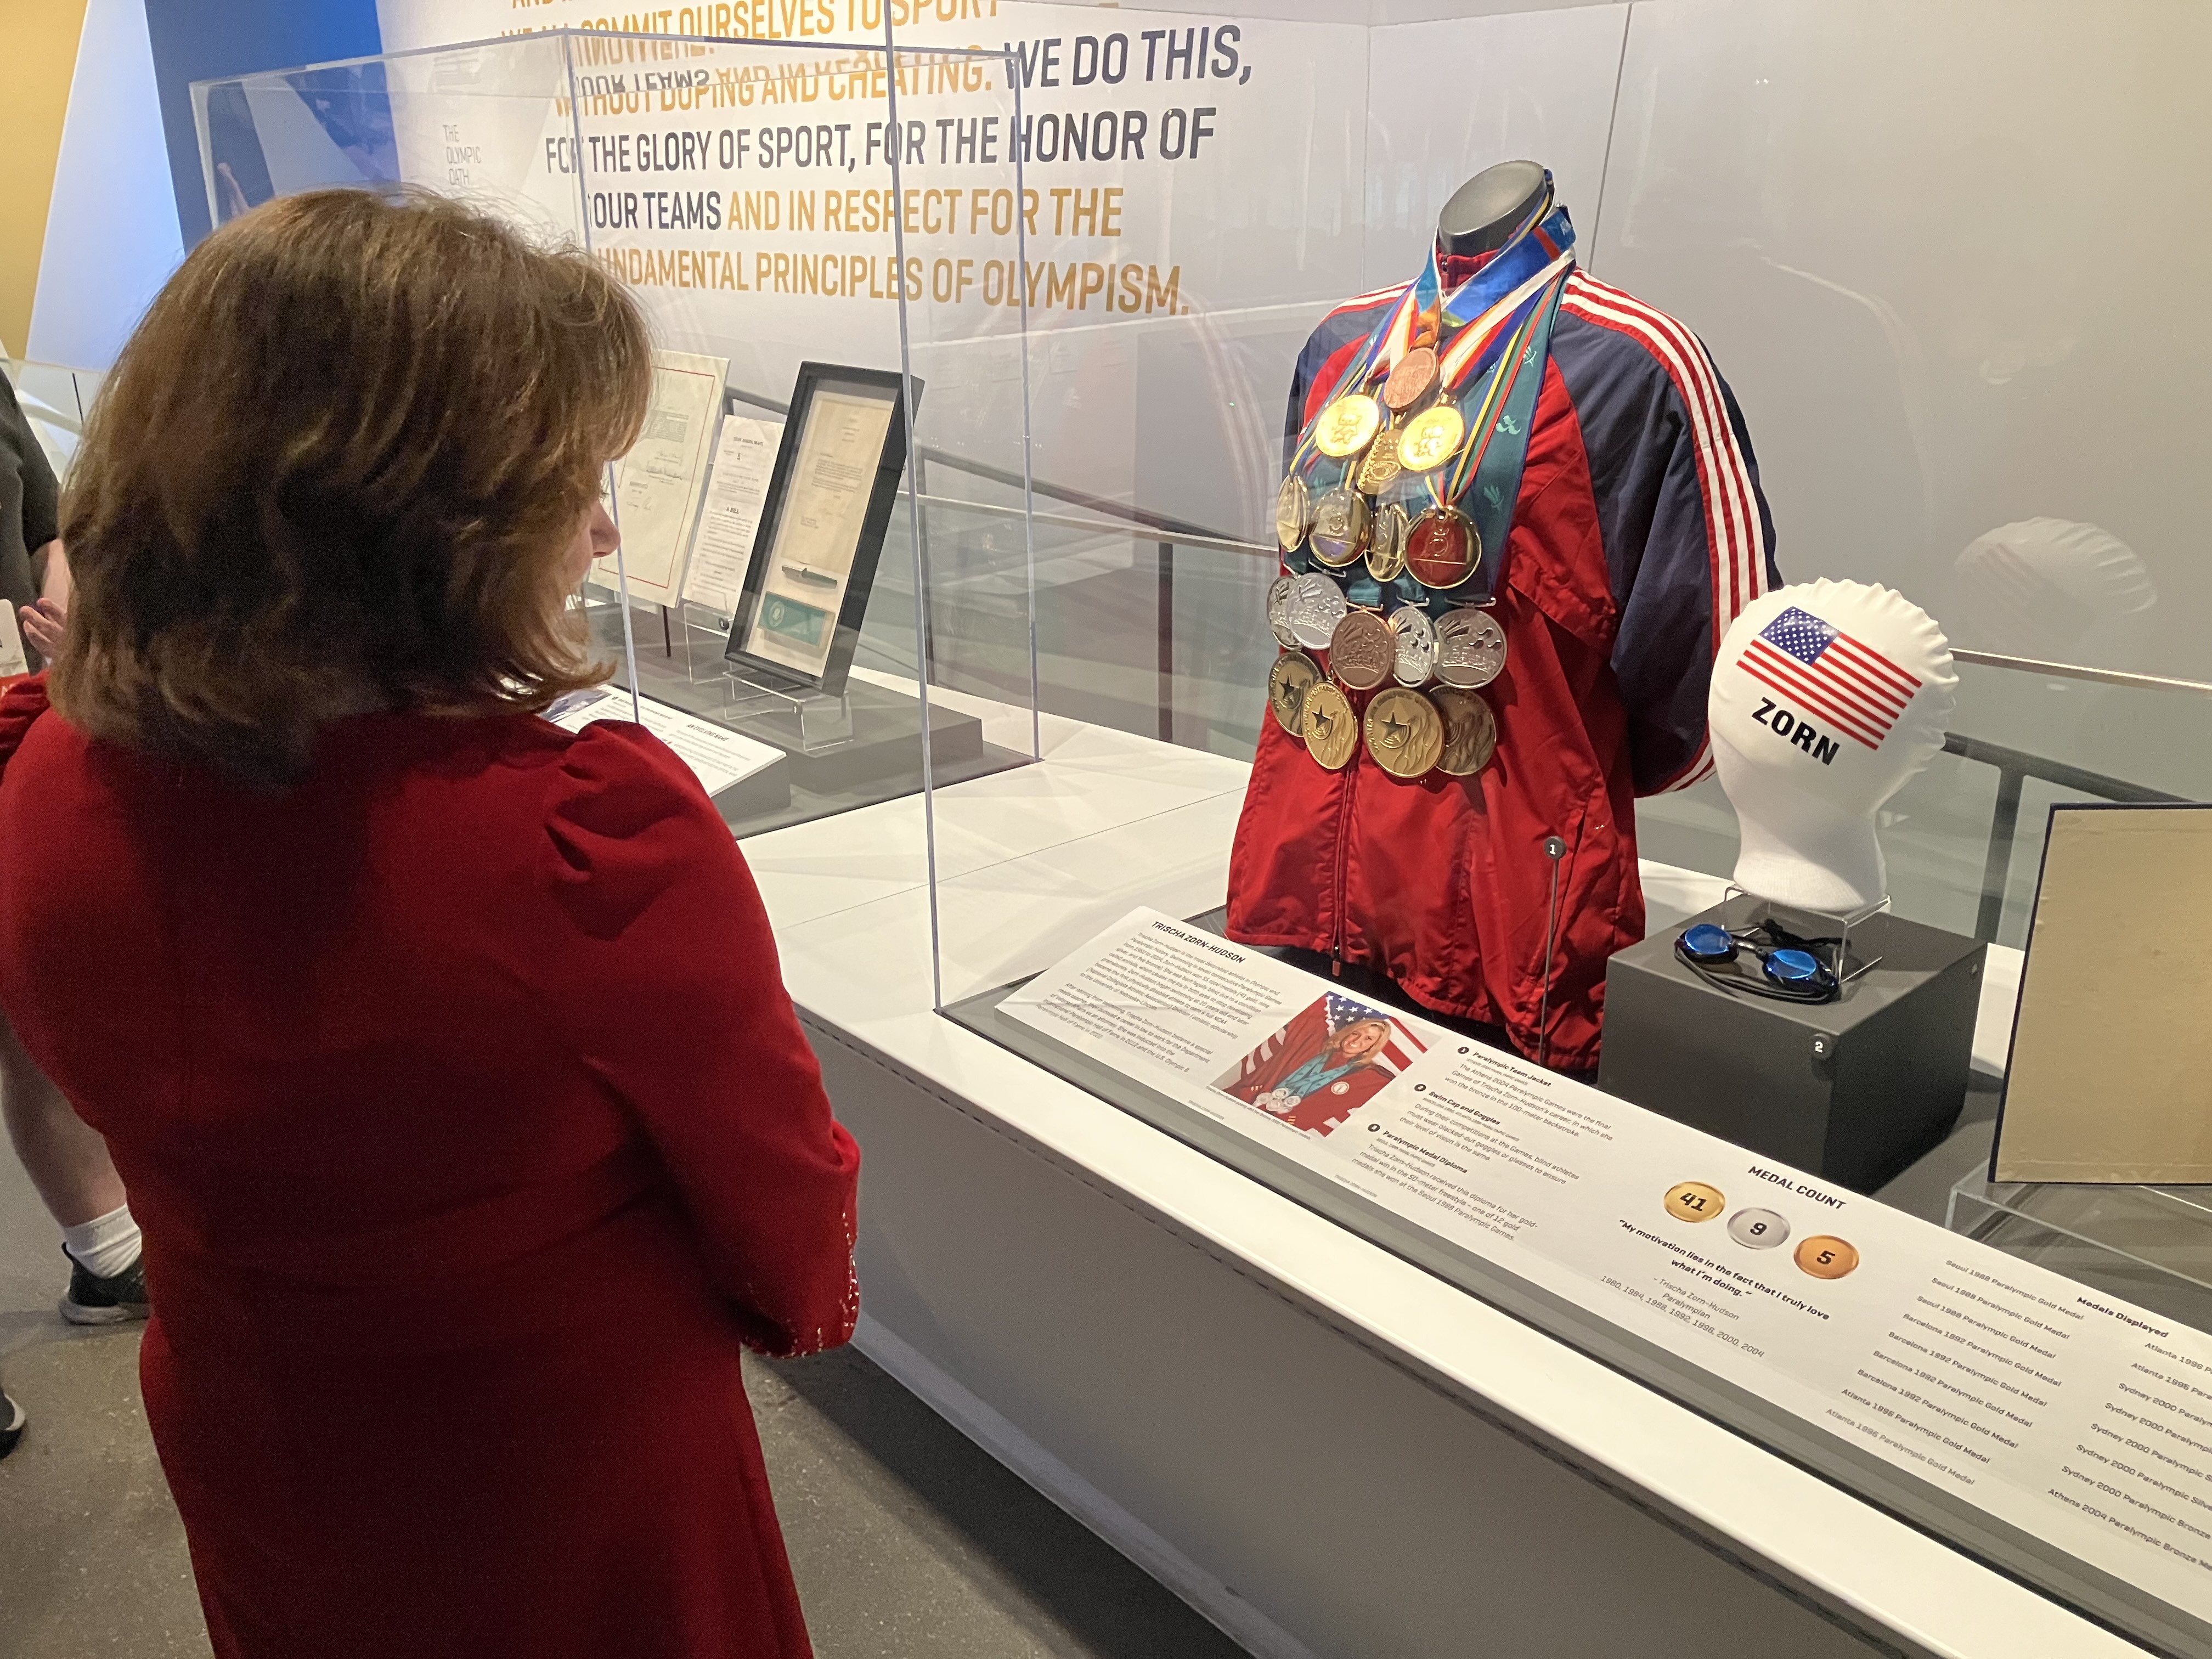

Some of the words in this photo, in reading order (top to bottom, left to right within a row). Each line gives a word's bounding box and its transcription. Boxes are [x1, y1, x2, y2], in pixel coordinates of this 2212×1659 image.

[679, 0, 834, 39] OURSELVES
[1003, 38, 1062, 89] WE
[1071, 32, 1130, 86] DO
[1140, 24, 1252, 87] THIS,
[443, 125, 460, 142] THE
[588, 134, 632, 173] THE
[636, 130, 712, 172] GLORY
[719, 128, 752, 169] OF
[758, 123, 856, 173] SPORT,
[865, 120, 927, 166] FOR
[935, 116, 1000, 165] THE
[1008, 110, 1148, 164] HONOR
[1159, 107, 1217, 161] OF
[446, 146, 482, 164] OLYMPIC
[593, 192, 639, 229] OUR
[642, 191, 722, 231] TEAMS
[727, 190, 780, 232] AND
[788, 189, 816, 232] IN
[824, 189, 963, 235] RESPECT
[970, 188, 1040, 236] FOR
[1048, 188, 1124, 238] THE
[596, 247, 750, 292] NDAMENTAL
[755, 251, 923, 303] PRINCIPLES
[932, 257, 974, 304] OF
[983, 259, 1189, 316] OLYMPISM.
[1751, 696, 1841, 766] ZORN
[1549, 844, 1556, 855] 1
[1151, 921, 1186, 939] TRISCHA
[1183, 934, 1246, 963] ZORN-HUDSON
[1815, 1041, 1823, 1053] 2
[1472, 1051, 1509, 1070] Paralympic
[1509, 1066, 1528, 1077] Team
[1526, 1074, 1551, 1087] Jacket
[1428, 1091, 1448, 1102] Swim
[1446, 1098, 1460, 1108] Cap
[1459, 1105, 1475, 1114] and
[1472, 1110, 1500, 1125] Goggles
[1444, 1076, 1458, 1085] won
[1457, 1081, 1469, 1090] the
[1468, 1086, 1490, 1098] bronze
[1496, 1098, 1508, 1107] the
[1507, 1103, 1543, 1121] 100-meter
[1451, 1070, 1473, 1082] Games
[1480, 1081, 1503, 1094] Trischa
[1579, 1124, 1600, 1136] which
[1599, 1132, 1613, 1141] she
[1459, 1063, 1471, 1071] The
[1470, 1068, 1492, 1081] Athens
[1491, 1077, 1510, 1087] 2004
[1508, 1084, 1544, 1102] Paralympic
[1543, 1098, 1567, 1111] Games
[1566, 1109, 1583, 1118] were
[1583, 1115, 1595, 1124] the
[1594, 1120, 1612, 1130] final
[1382, 1130, 1420, 1151] Paralympic
[1418, 1147, 1441, 1160] Medal
[1438, 1156, 1468, 1173] Diploma
[1679, 1192, 1707, 1212] 41
[1747, 1165, 1794, 1190] MEDAL
[1795, 1185, 1847, 1209] COUNT
[1749, 1222, 1768, 1235] 9
[1635, 1229, 1686, 1255] motivation
[1685, 1251, 1704, 1263] lies
[1703, 1259, 1715, 1268] in
[1715, 1264, 1732, 1276] the
[1732, 1272, 1754, 1286] fact
[1753, 1282, 1776, 1296] that
[1781, 1294, 1807, 1310] truly
[1806, 1305, 1830, 1320] love
[1671, 1259, 1696, 1274] what
[1815, 1250, 1836, 1265] 5
[1599, 1275, 1622, 1290] 1980,
[1622, 1285, 1645, 1301] 1984,
[1645, 1297, 1668, 1312] 1988,
[1668, 1308, 1691, 1323] 1992,
[1691, 1319, 1715, 1335] 1996,
[1716, 1330, 1739, 1347] 2000,
[1740, 1342, 1765, 1357] 2004
[1658, 1278, 1687, 1296] Trischa
[1686, 1291, 1739, 1321] Zorn-Hudson
[1661, 1292, 1711, 1319] Paralympian
[2076, 1296, 2114, 1316] Medals
[2114, 1312, 2169, 1338] Displayed
[2130, 1362, 2164, 1380] Atlanta
[2164, 1375, 2190, 1390] 1996
[2144, 1342, 2177, 1359] Atlanta
[2179, 1356, 2203, 1369] 1996
[2104, 1402, 2138, 1421] Sydney
[2138, 1417, 2164, 1432] 2000
[2118, 1382, 2152, 1401] Sydney
[2152, 1397, 2177, 1412] 2000
[2090, 1423, 2124, 1442] Sydney
[2124, 1438, 2150, 1453] 2000
[2150, 1449, 2204, 1477] Paralympic
[2075, 1443, 2111, 1464] Sydney
[2109, 1459, 2136, 1475] 2000
[2136, 1471, 2190, 1500] Paralympic
[2061, 1465, 2096, 1486] Sydney
[2096, 1481, 2122, 1497] 2000
[2122, 1493, 2176, 1523] Paralympic
[2176, 1519, 2211, 1539] Bronze
[2047, 1488, 2080, 1508] Athens
[2081, 1503, 2108, 1520] 2004
[2107, 1516, 2162, 1547] Paralympic
[2162, 1542, 2197, 1564] Bronze
